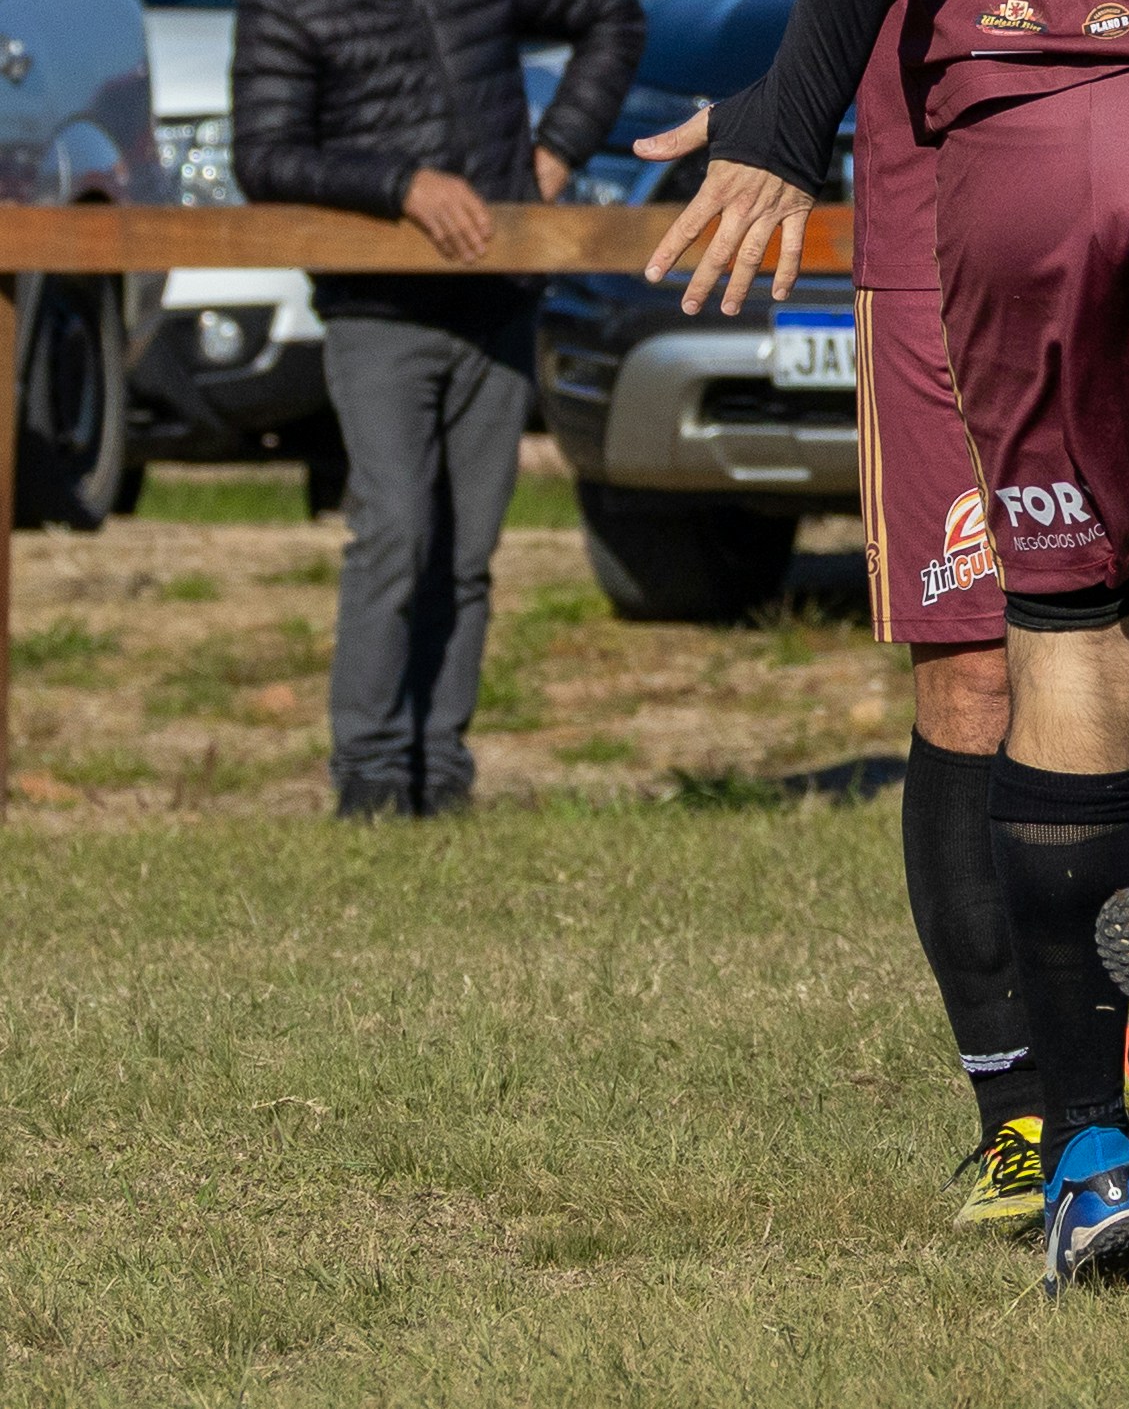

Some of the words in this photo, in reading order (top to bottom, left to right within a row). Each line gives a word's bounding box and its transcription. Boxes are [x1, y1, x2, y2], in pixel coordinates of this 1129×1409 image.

[1089, 17, 1121, 34] PLANO
[1120, 16, 1129, 28] B
[1013, 531, 1076, 552] NEGÓCIOS
